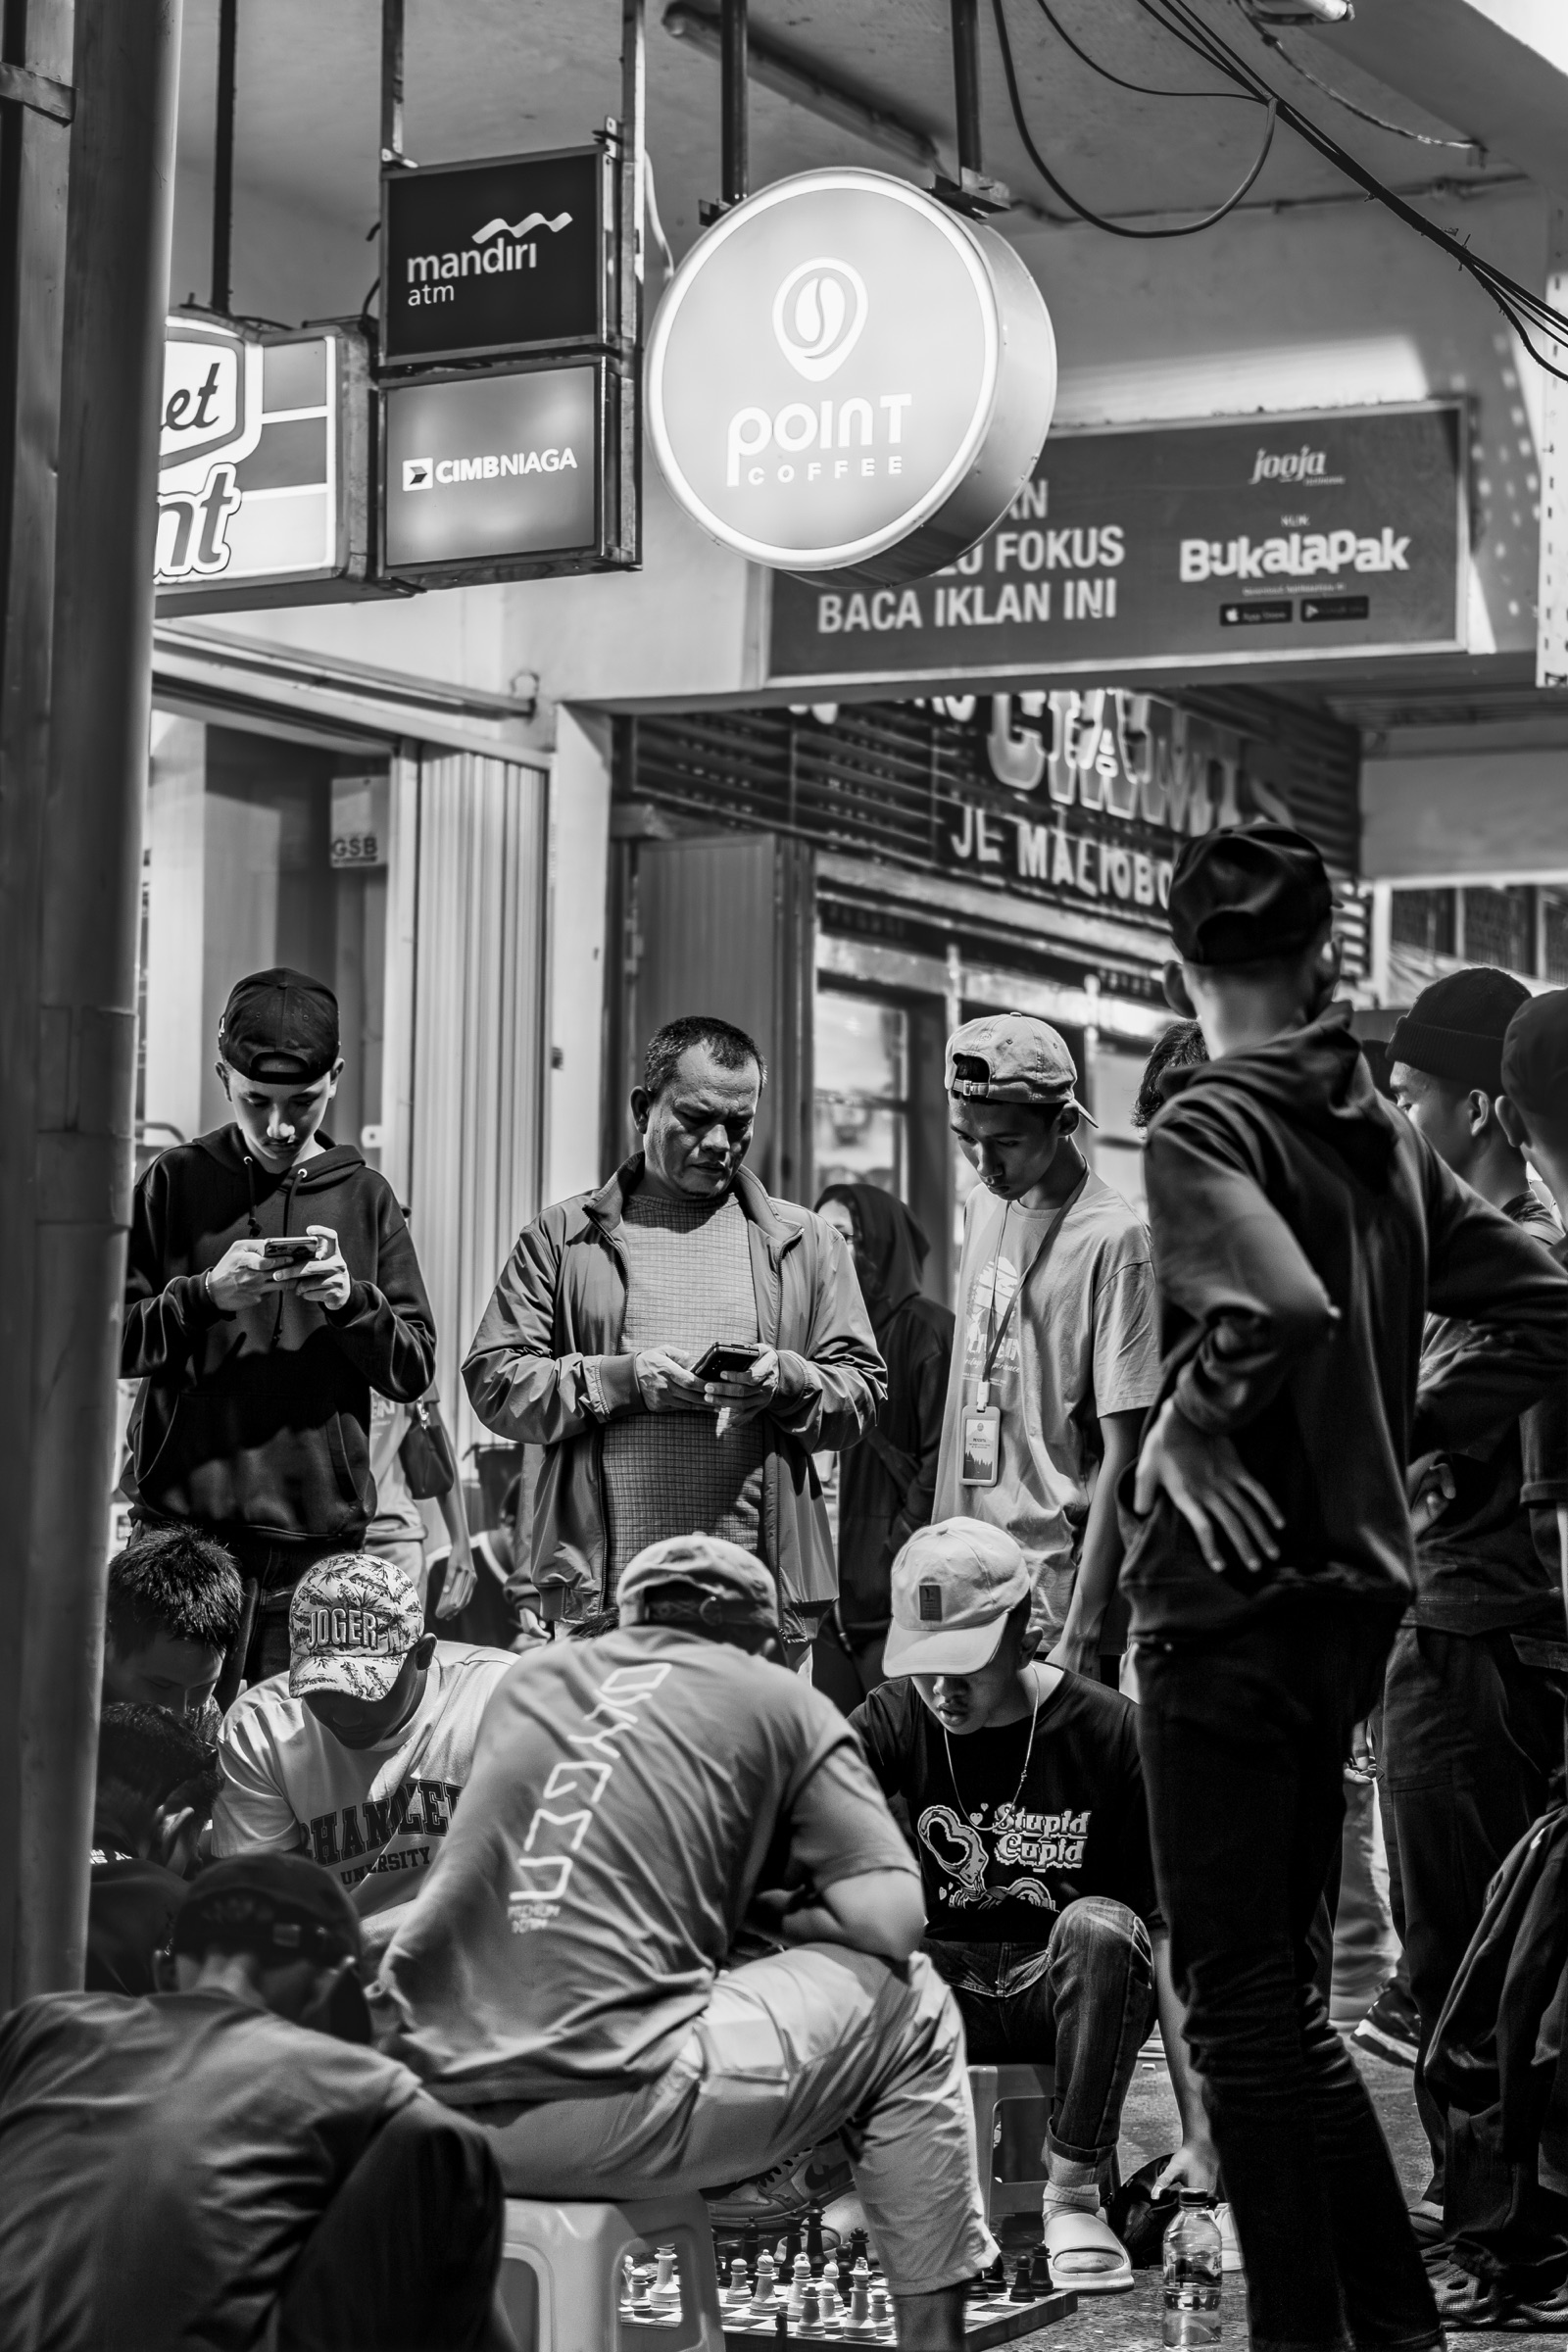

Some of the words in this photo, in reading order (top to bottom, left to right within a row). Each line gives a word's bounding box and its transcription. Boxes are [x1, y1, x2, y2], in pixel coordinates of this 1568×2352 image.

[408, 237, 537, 283] mandiri
[408, 284, 455, 306] atm
[160, 362, 221, 431] et
[748, 455, 903, 486] COFFEE
[996, 524, 1126, 572] FOKUS
[817, 589, 923, 634] BACA
[934, 581, 1051, 628] IKLAN
[1063, 577, 1117, 620] INI
[331, 836, 378, 857] GSB
[306, 1607, 379, 1650] JOGER
[993, 1801, 1093, 1841] Stupid
[995, 1834, 1086, 1873] Cupid
